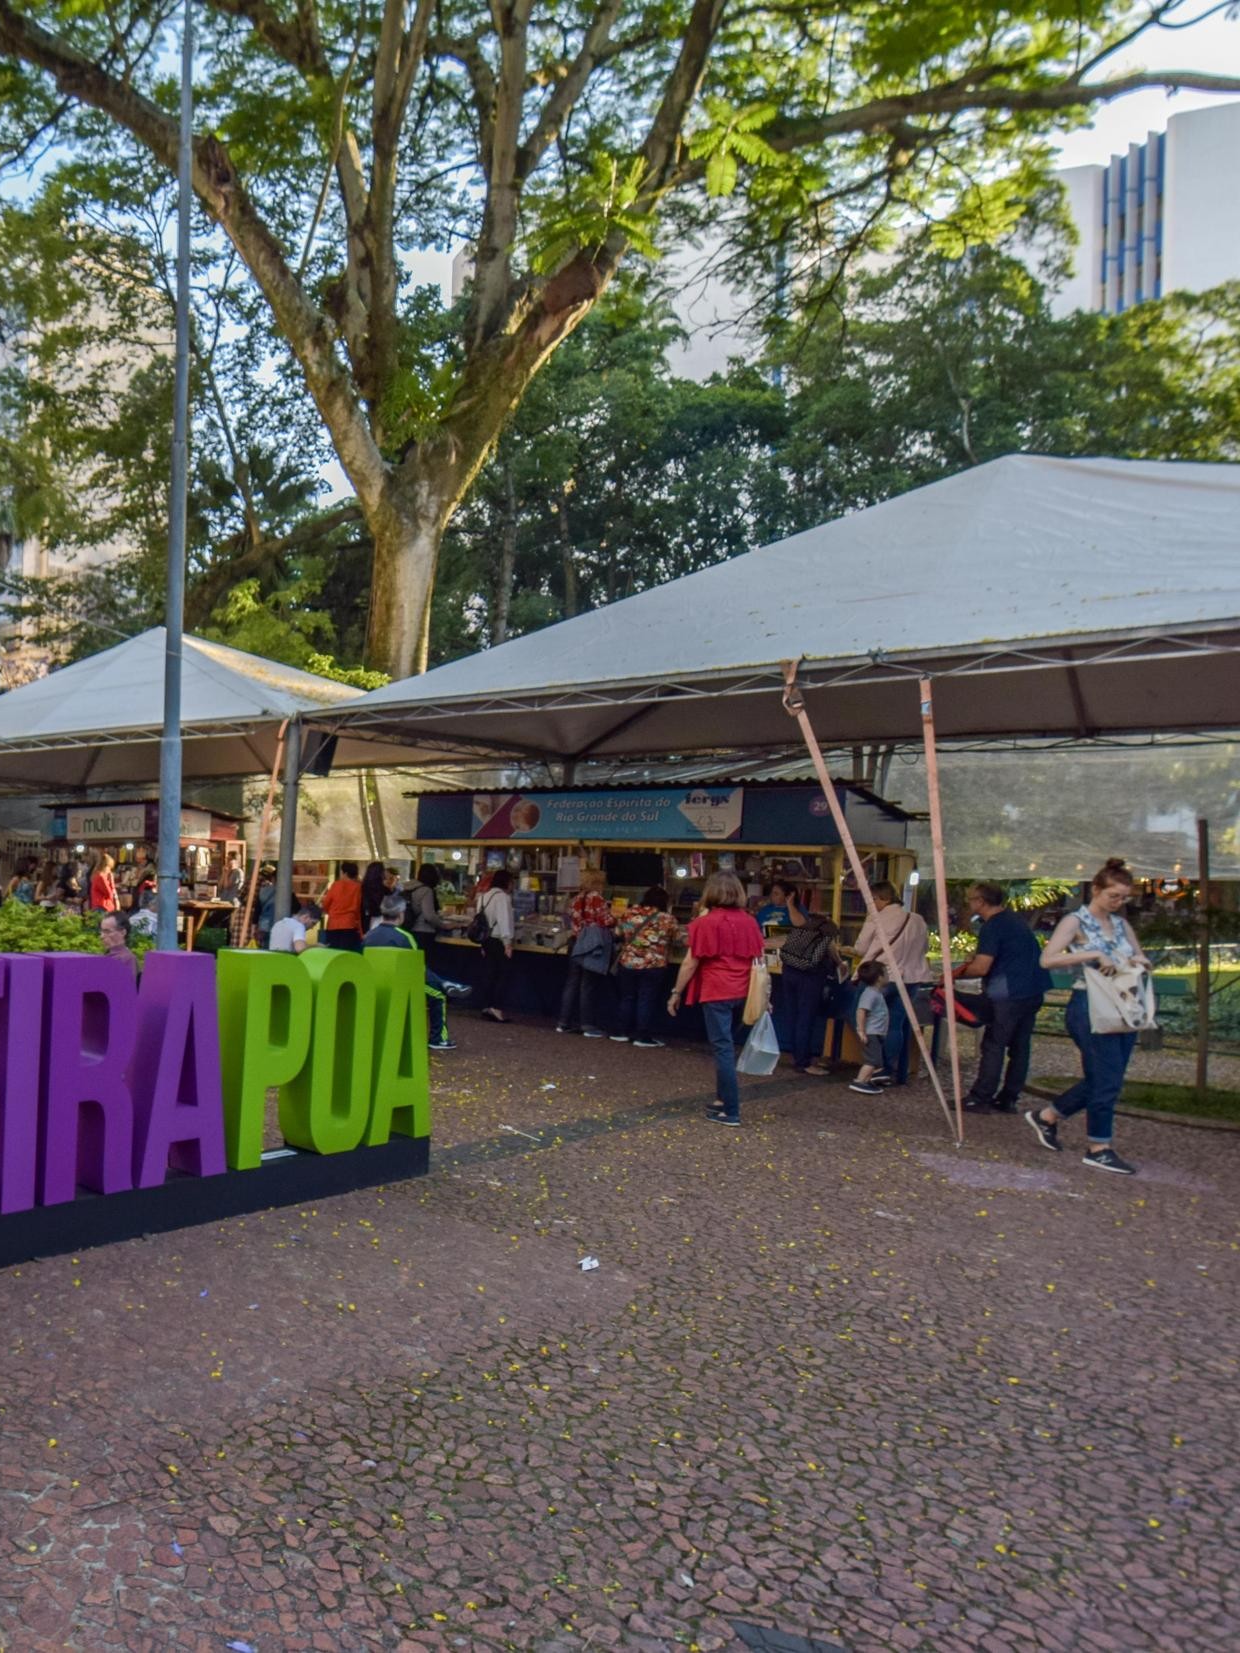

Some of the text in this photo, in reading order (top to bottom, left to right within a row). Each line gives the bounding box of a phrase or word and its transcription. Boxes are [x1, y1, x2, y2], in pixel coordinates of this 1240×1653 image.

[655, 796, 671, 807] do
[555, 809, 659, 822] Rio Grande do Sul
